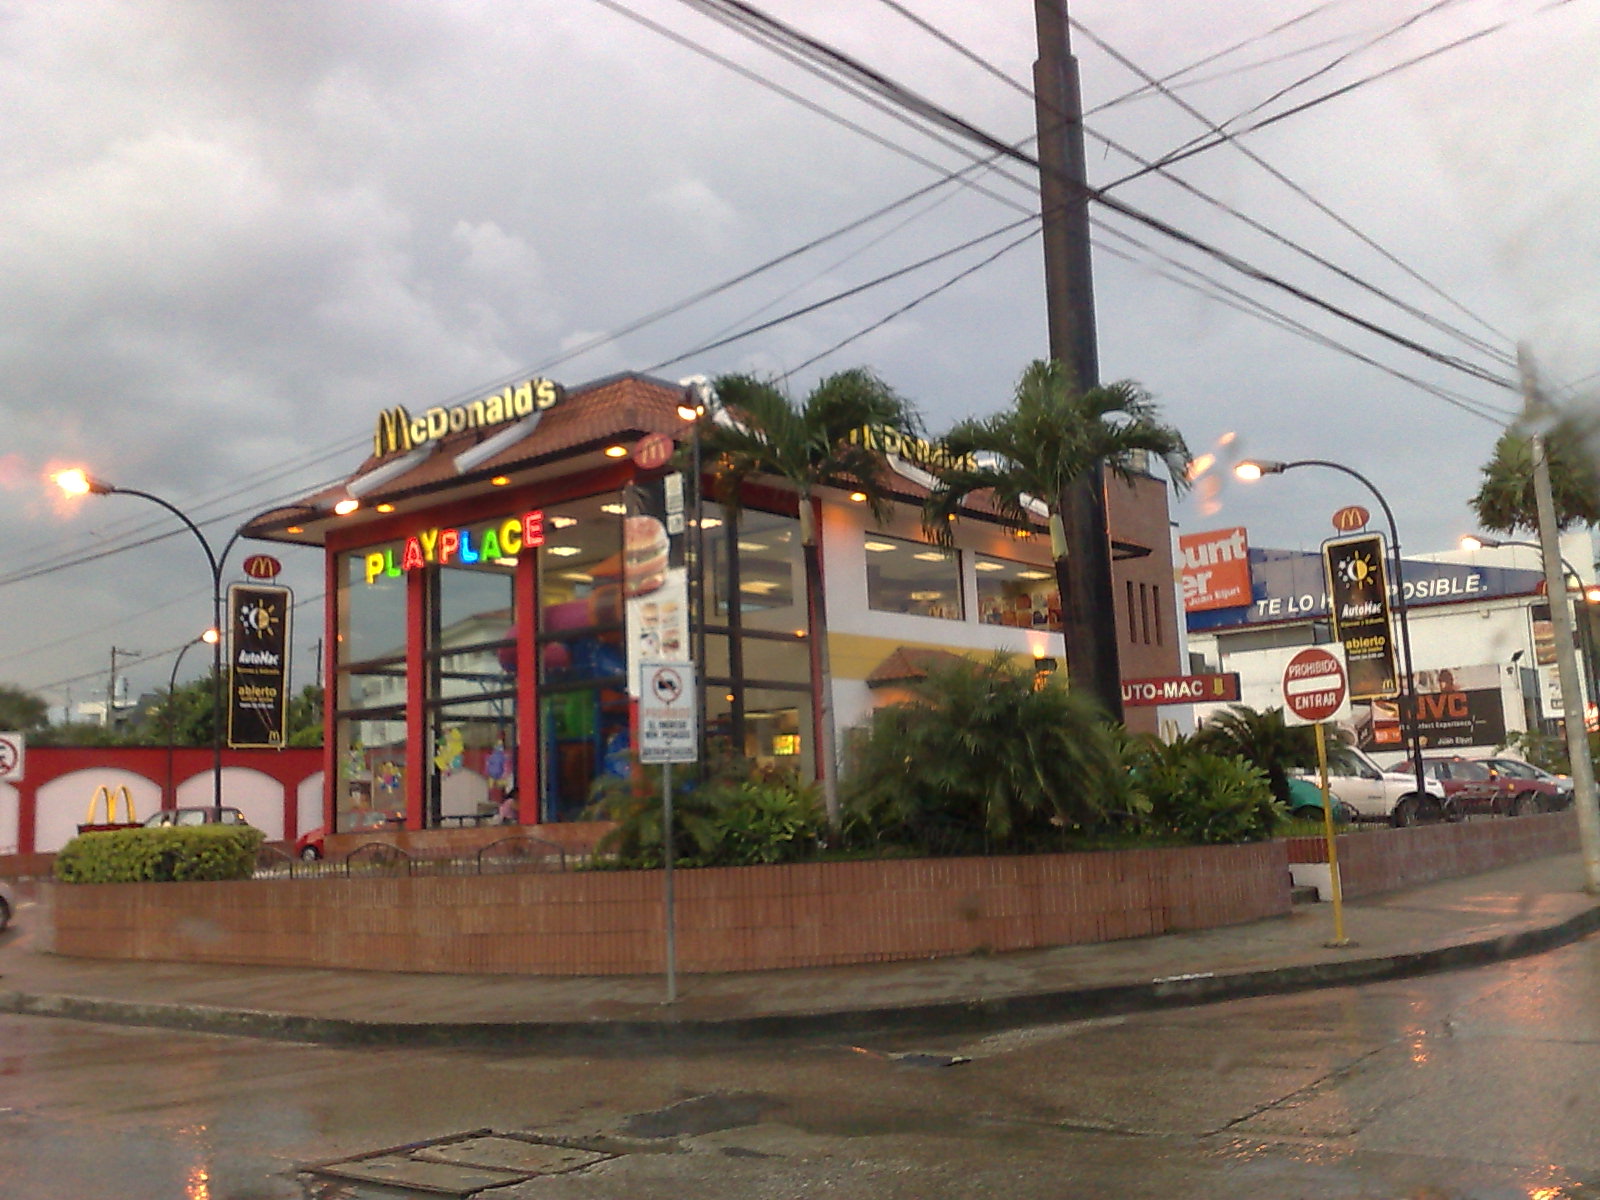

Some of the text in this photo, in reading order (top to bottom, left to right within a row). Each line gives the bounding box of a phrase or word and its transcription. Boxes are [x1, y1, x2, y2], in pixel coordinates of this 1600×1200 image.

[374, 378, 557, 458] McDonald's
[365, 510, 544, 584] PLAYPLACE
[1257, 597, 1281, 615] TE
[1287, 594, 1314, 612] LO
[1342, 600, 1382, 618] AutoMac
[1345, 635, 1386, 650] abierto
[1288, 659, 1337, 677] PROHIBIDO
[238, 684, 277, 698] abierto
[1121, 680, 1203, 701] UTO-MAC
[1295, 692, 1336, 710] ENTRAR
[1408, 692, 1468, 720] JVC
